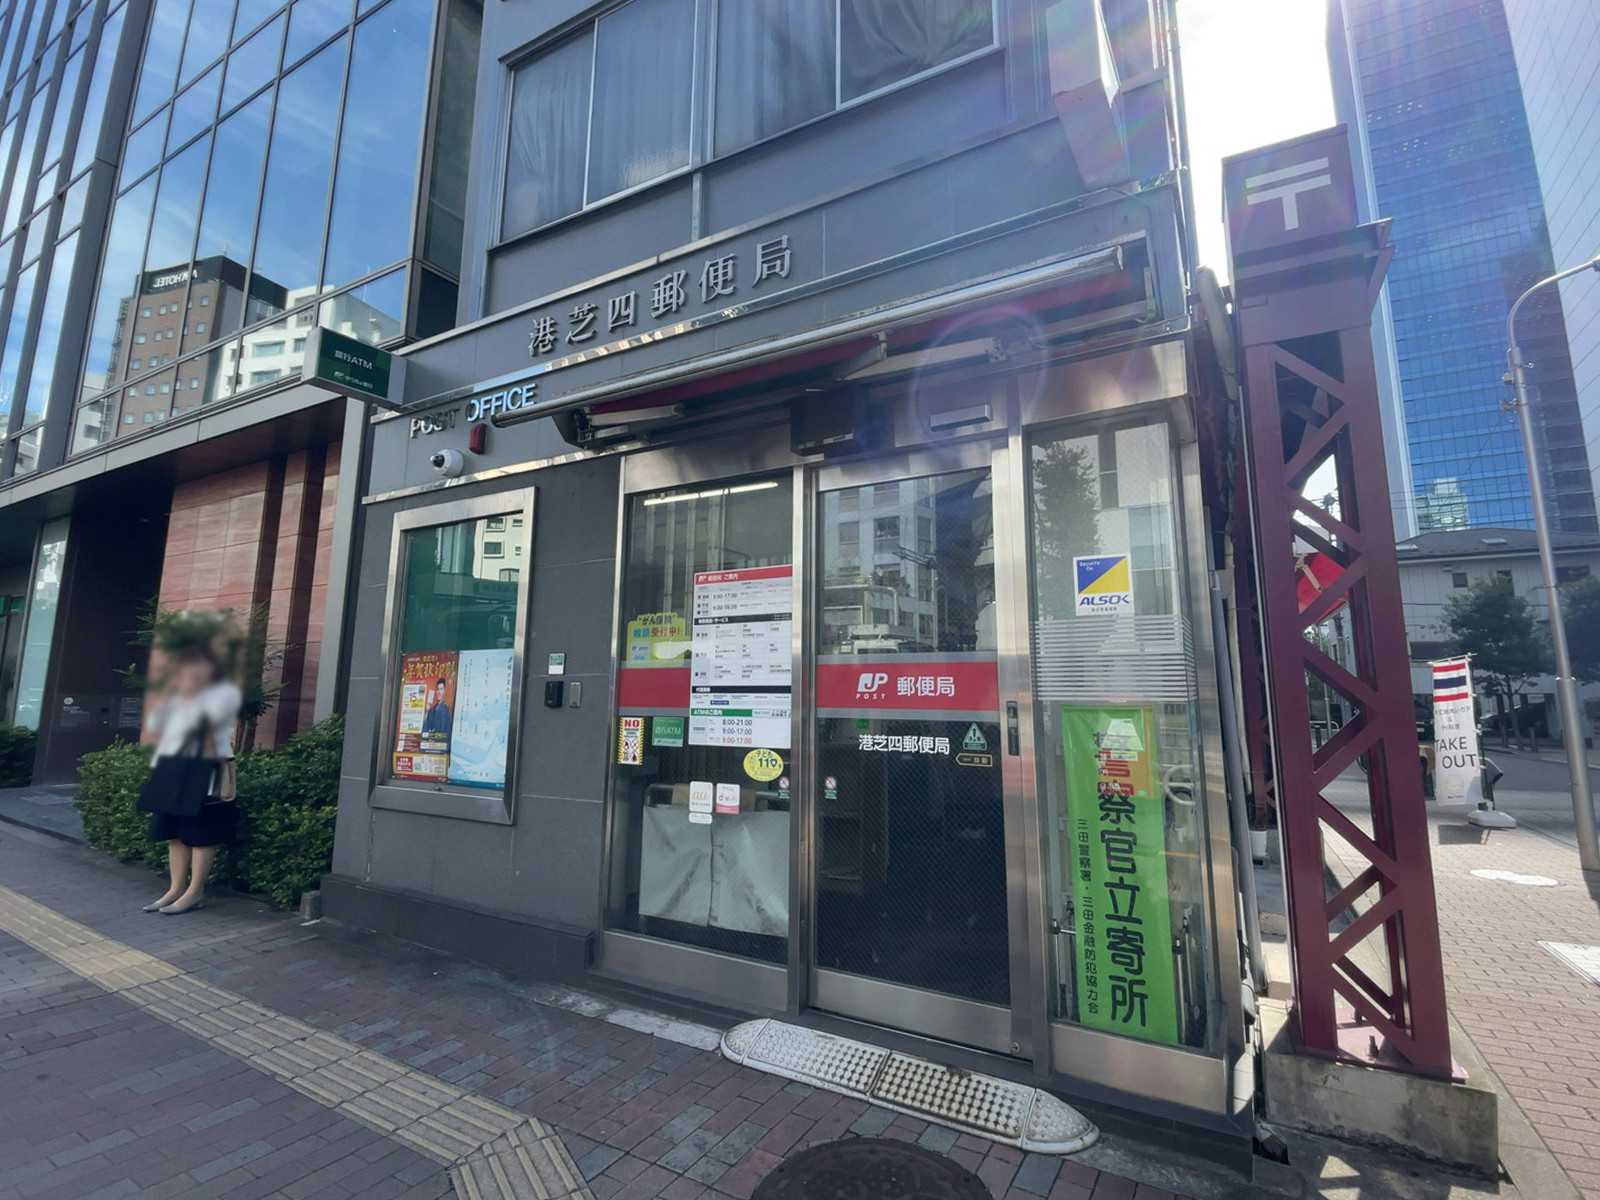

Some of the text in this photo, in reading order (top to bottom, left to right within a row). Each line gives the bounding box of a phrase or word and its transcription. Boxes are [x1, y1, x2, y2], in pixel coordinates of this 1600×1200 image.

[527, 234, 793, 357] 港芝四郵便局
[410, 383, 537, 439] POST OFFICE
[1079, 594, 1130, 606] ALSOK
[896, 676, 955, 697] 郵便局
[624, 719, 640, 727] NO
[858, 734, 950, 755] 港芝四郵便局
[1434, 736, 1468, 752] TAKE
[756, 750, 773, 758] 子ども
[1442, 753, 1477, 769] OUT
